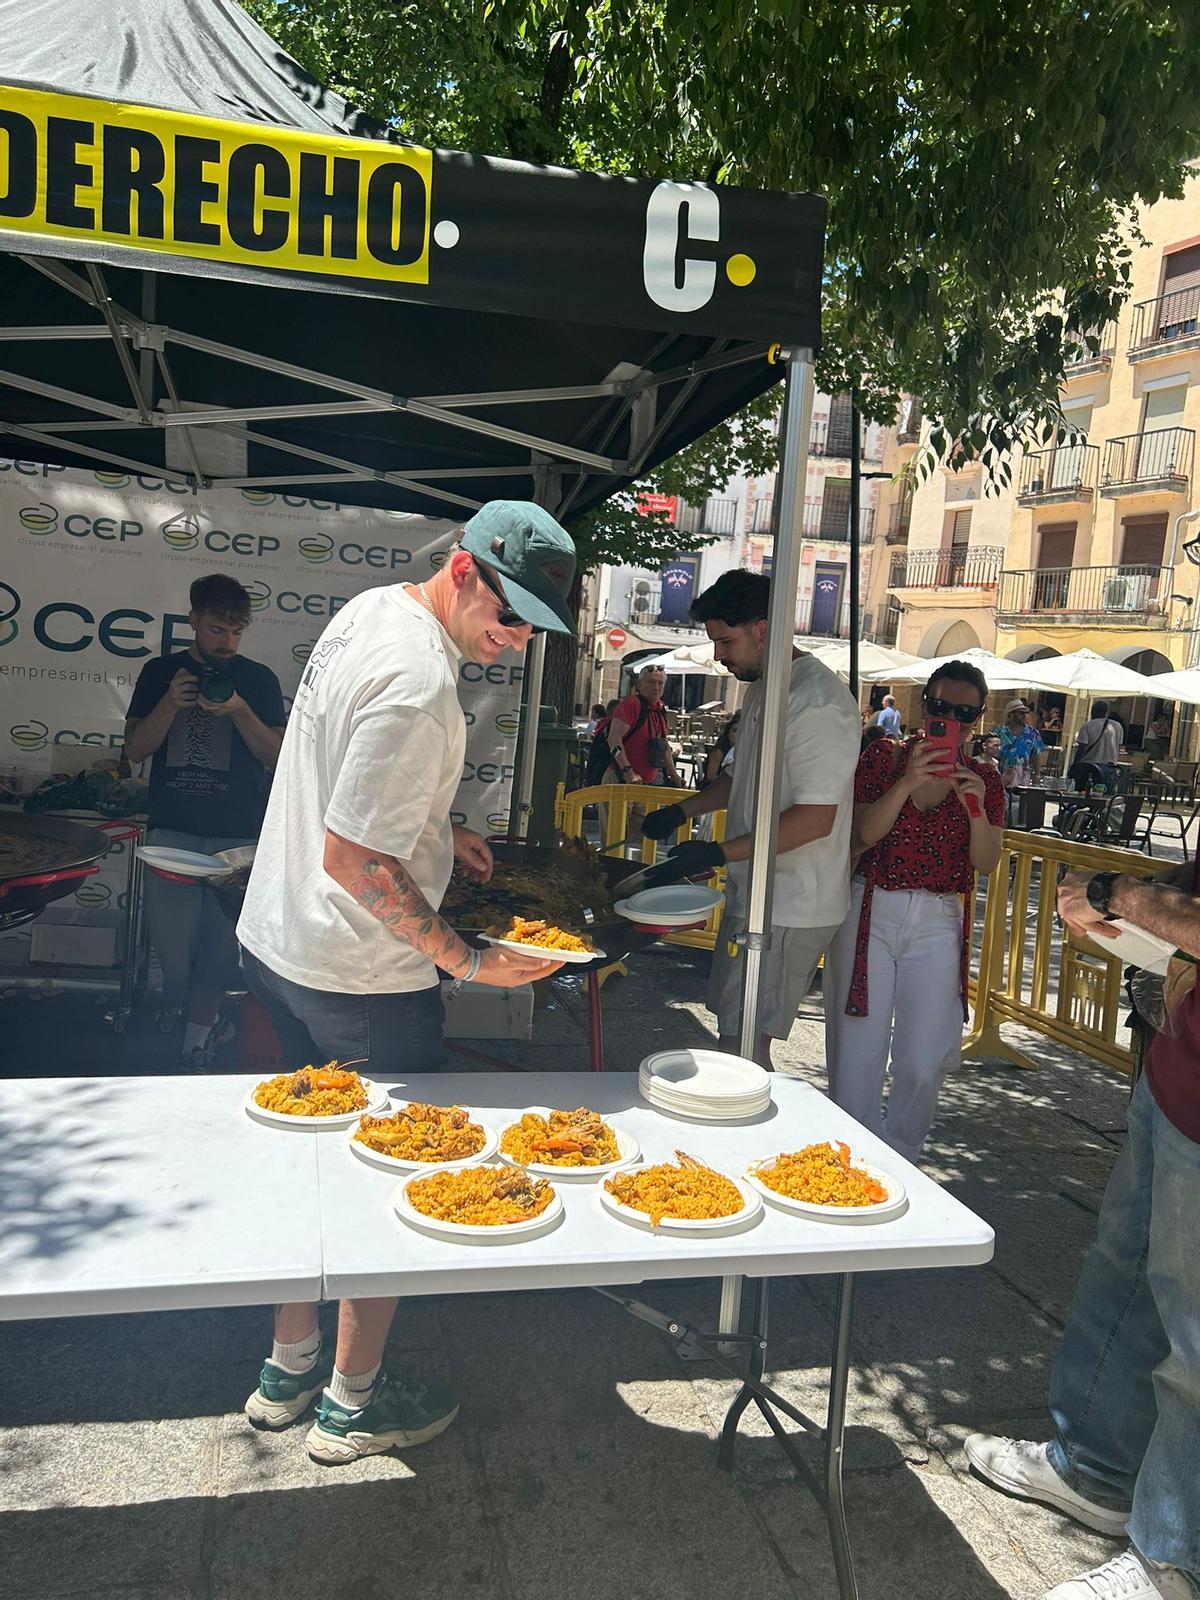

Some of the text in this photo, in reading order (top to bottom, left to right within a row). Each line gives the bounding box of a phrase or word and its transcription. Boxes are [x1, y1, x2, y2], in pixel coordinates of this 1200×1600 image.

[64, 514, 144, 541] CEP
[204, 530, 281, 557] CEP
[339, 543, 413, 569] CEP
[0, 663, 109, 685] empresarial
